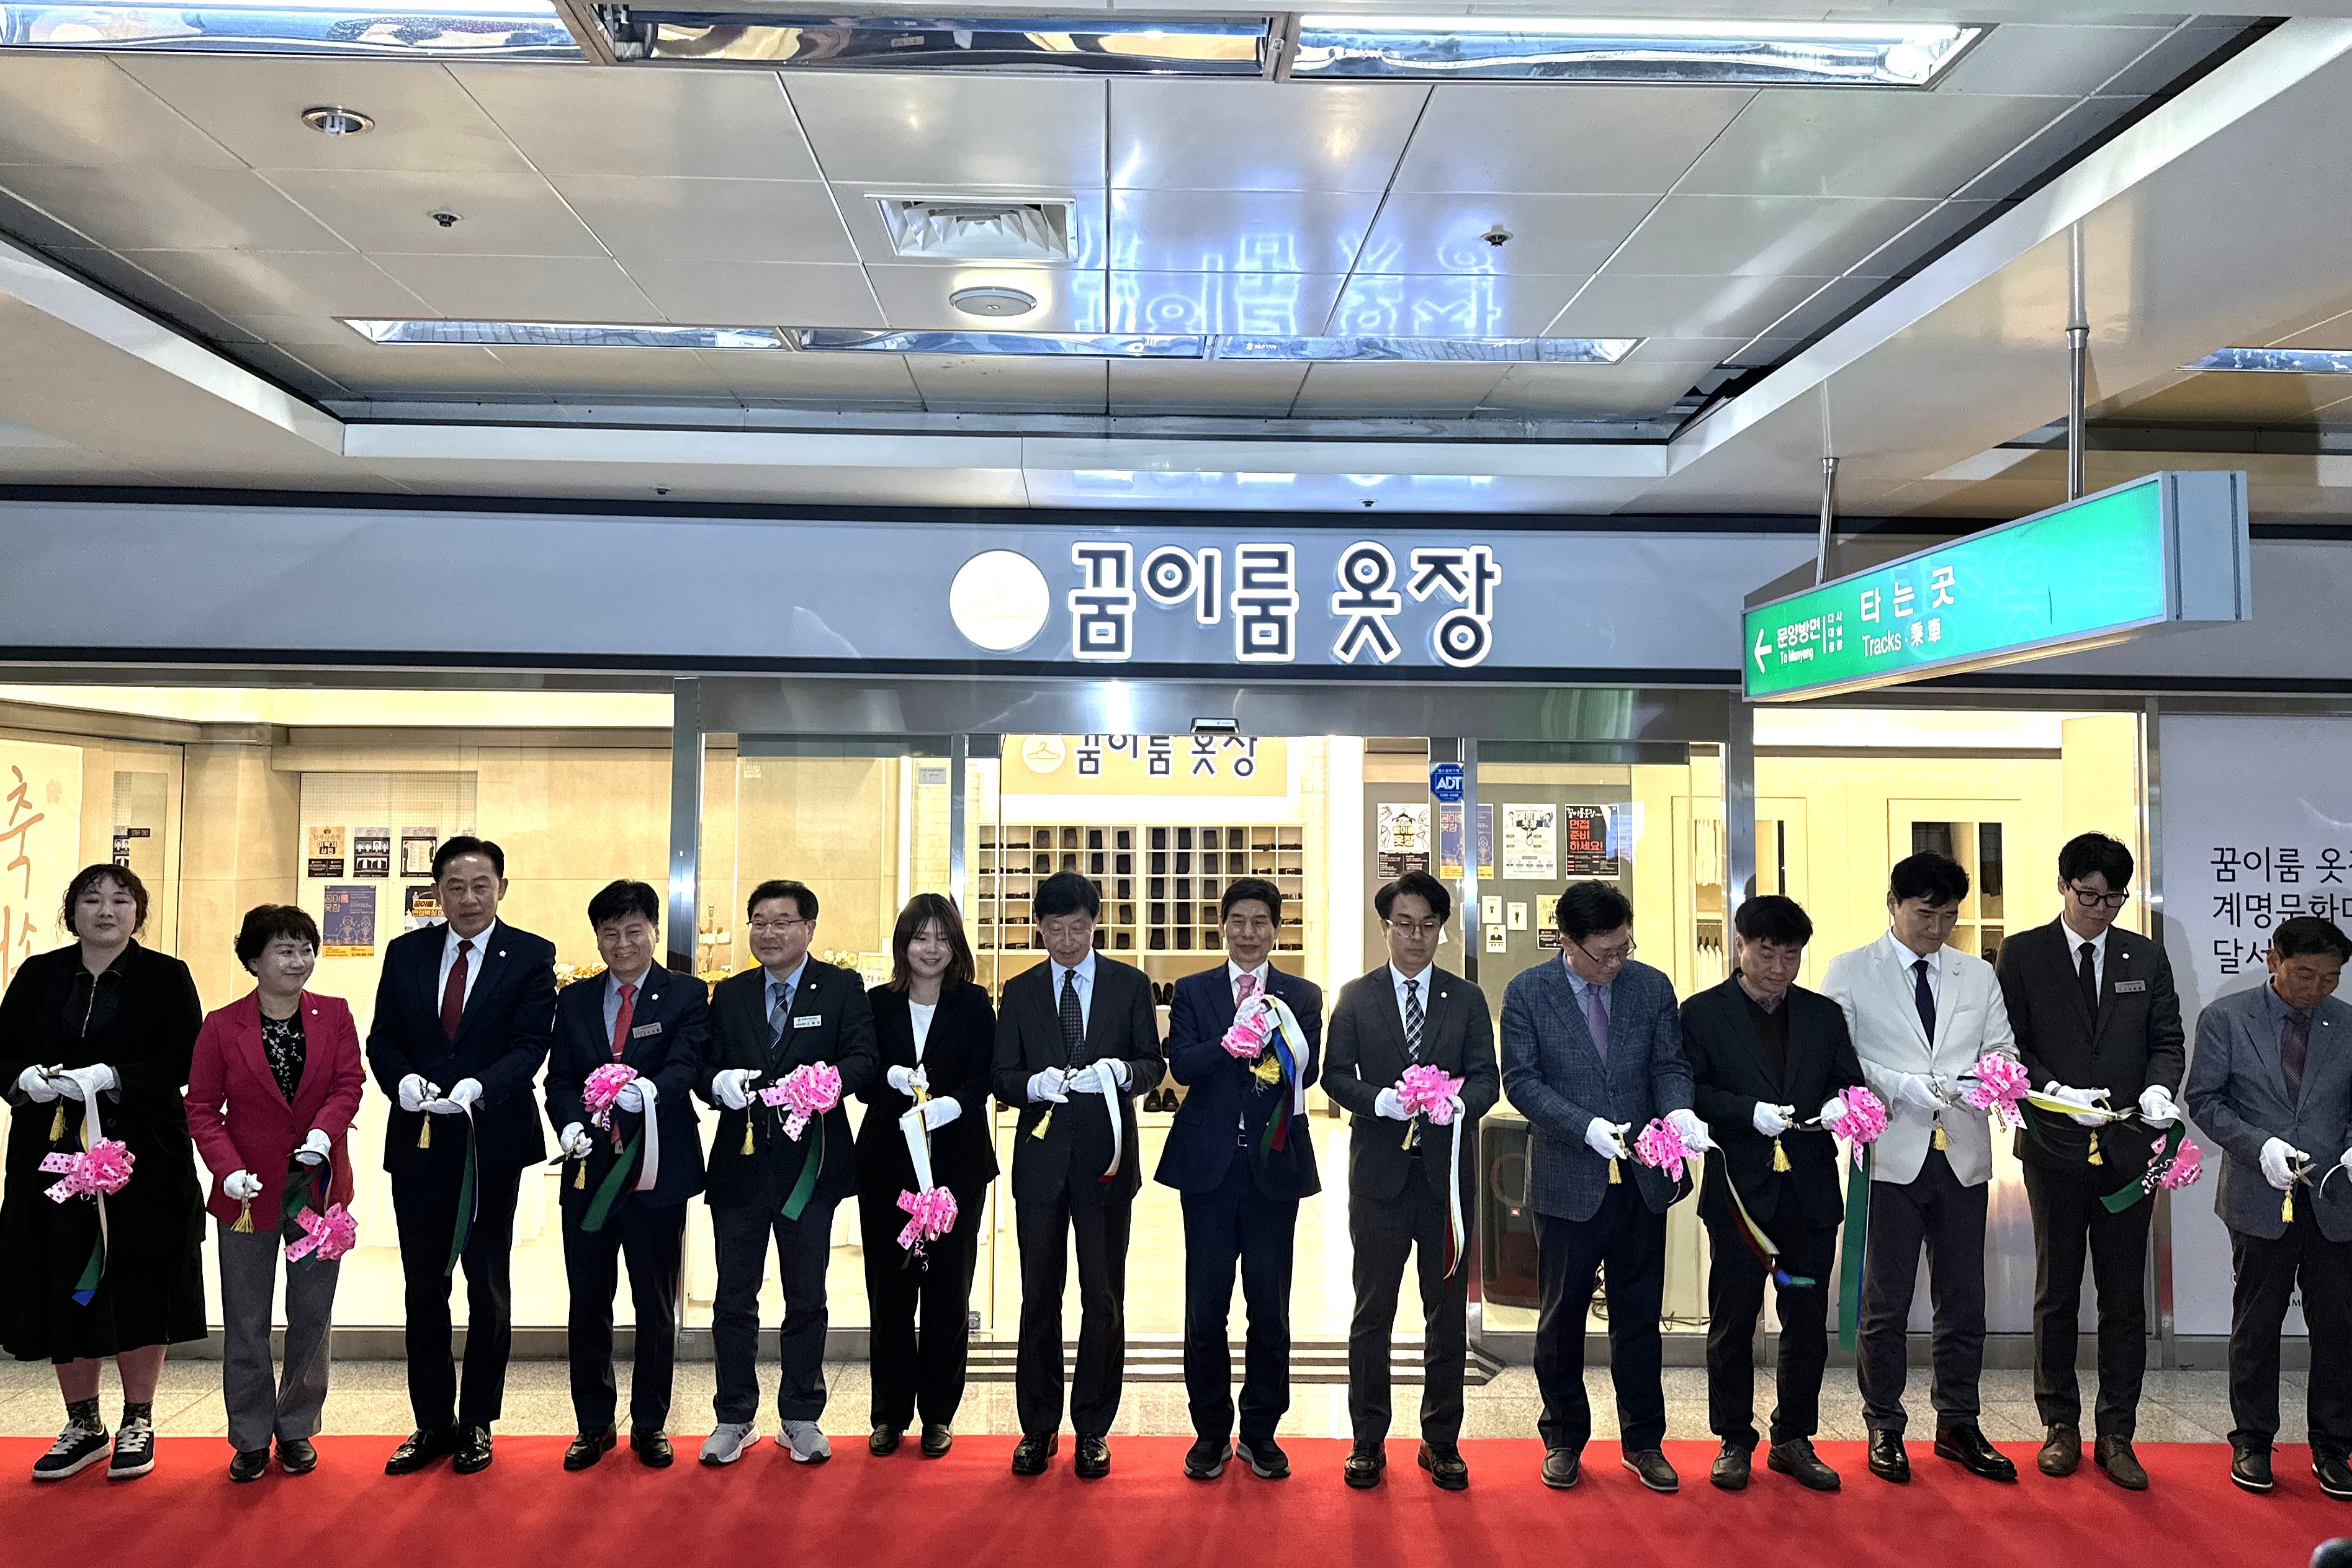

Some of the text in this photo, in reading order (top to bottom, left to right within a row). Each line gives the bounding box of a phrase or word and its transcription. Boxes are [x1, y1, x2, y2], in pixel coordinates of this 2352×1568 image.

[1071, 542, 1501, 667] 꿈이룸 옷장
[1777, 617, 1821, 648] 문양방면
[1862, 629, 1901, 657] Tracks
[1780, 652, 1788, 664] To
[1436, 776, 1462, 790] ADT
[1570, 830, 1589, 840] 준비
[1570, 841, 1603, 851] 하세요!
[2211, 847, 2352, 883] 꿈이룸 옷
